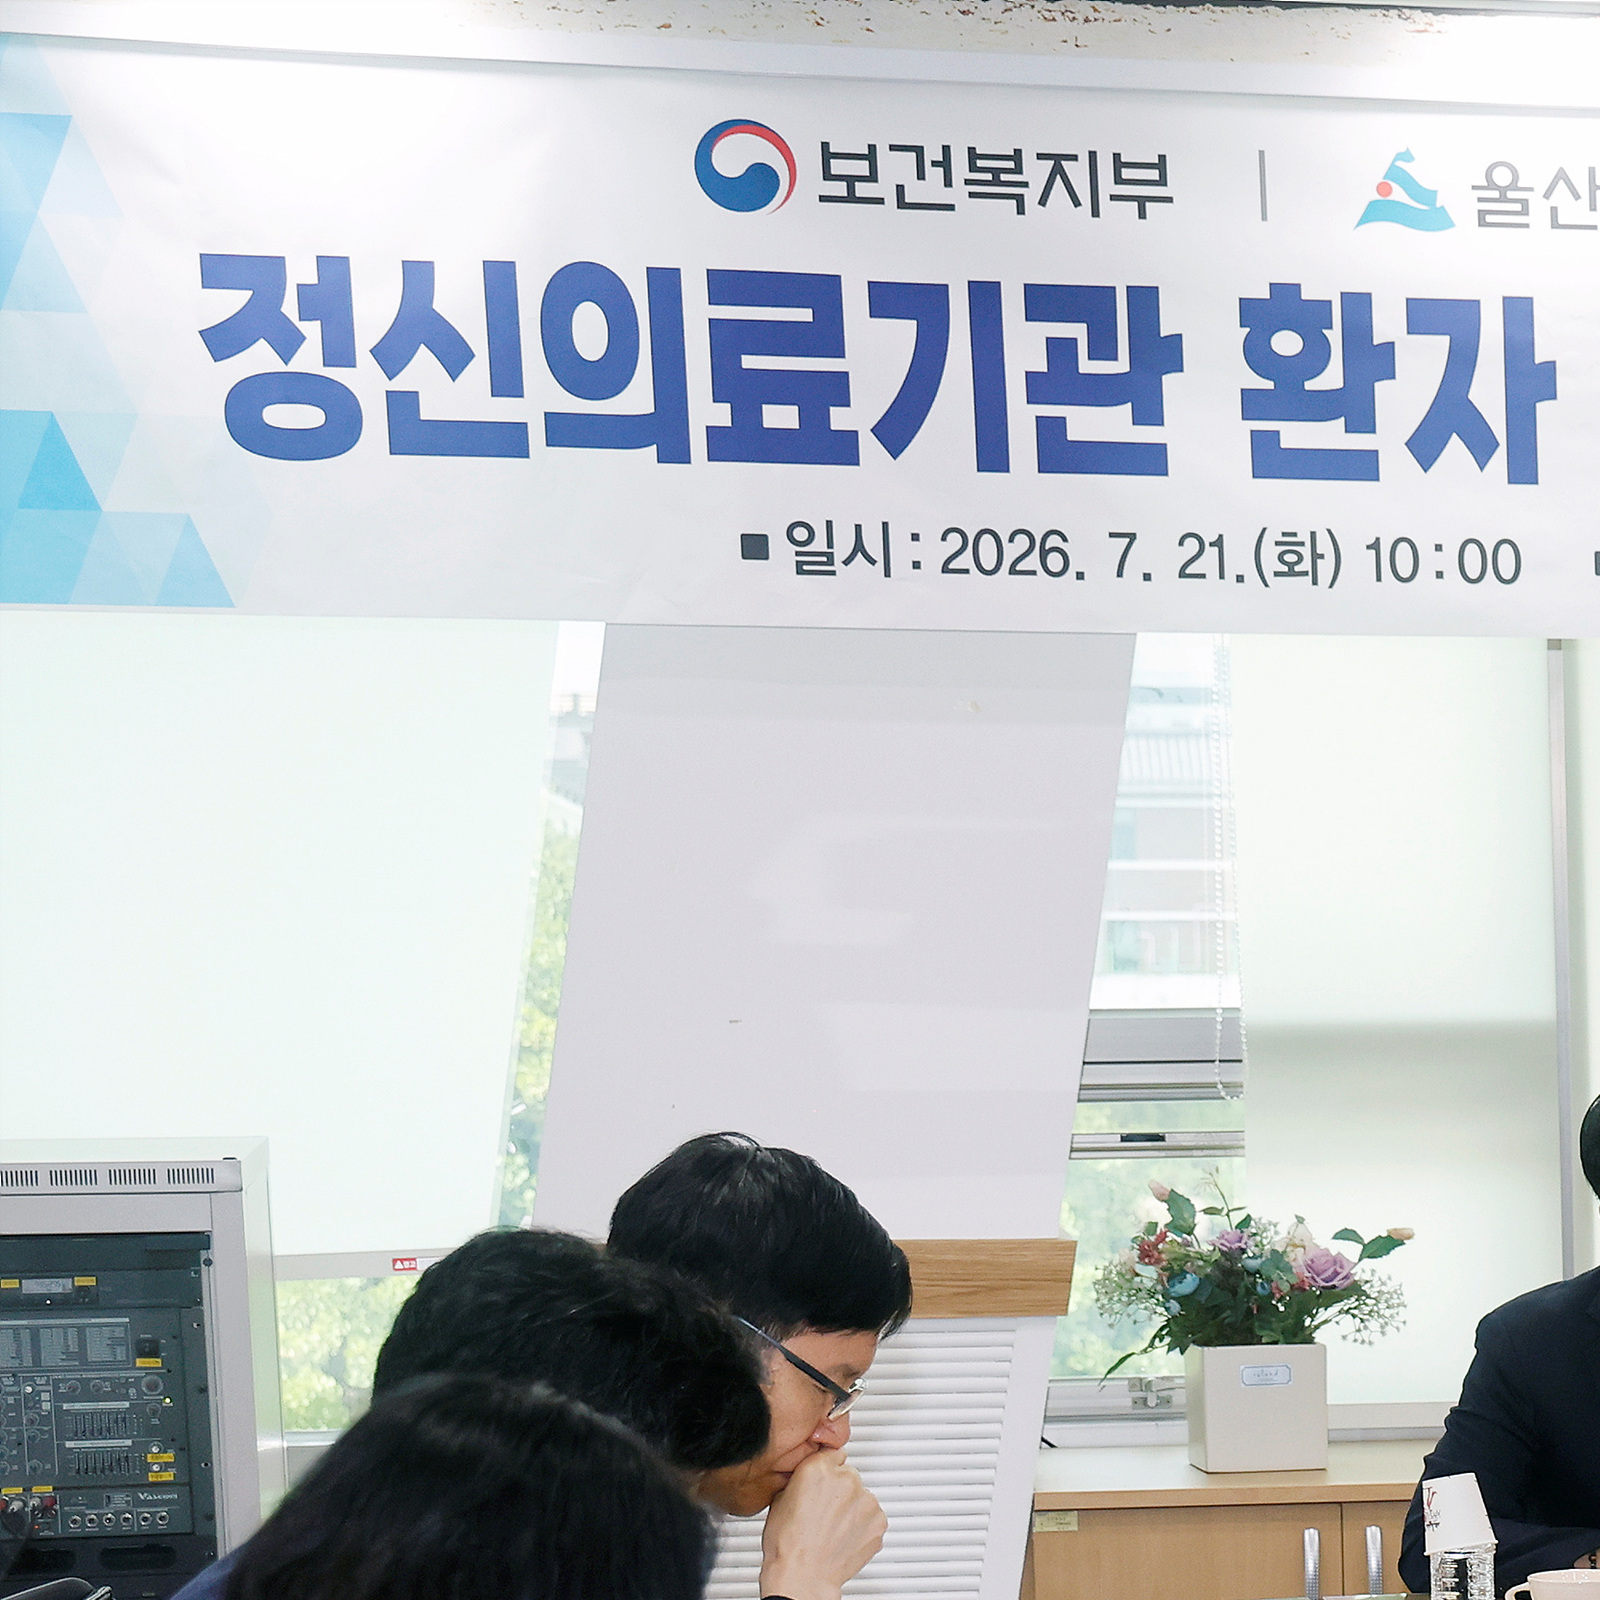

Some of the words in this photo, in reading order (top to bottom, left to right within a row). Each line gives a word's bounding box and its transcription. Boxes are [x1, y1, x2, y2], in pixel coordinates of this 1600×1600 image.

[818, 140, 1174, 220] 보건복지부
[198, 253, 1184, 477] 정신의료기관
[1238, 282, 1557, 485] 환자
[1108, 531, 1152, 582] 7.
[1178, 527, 1342, 589] 21.(화)
